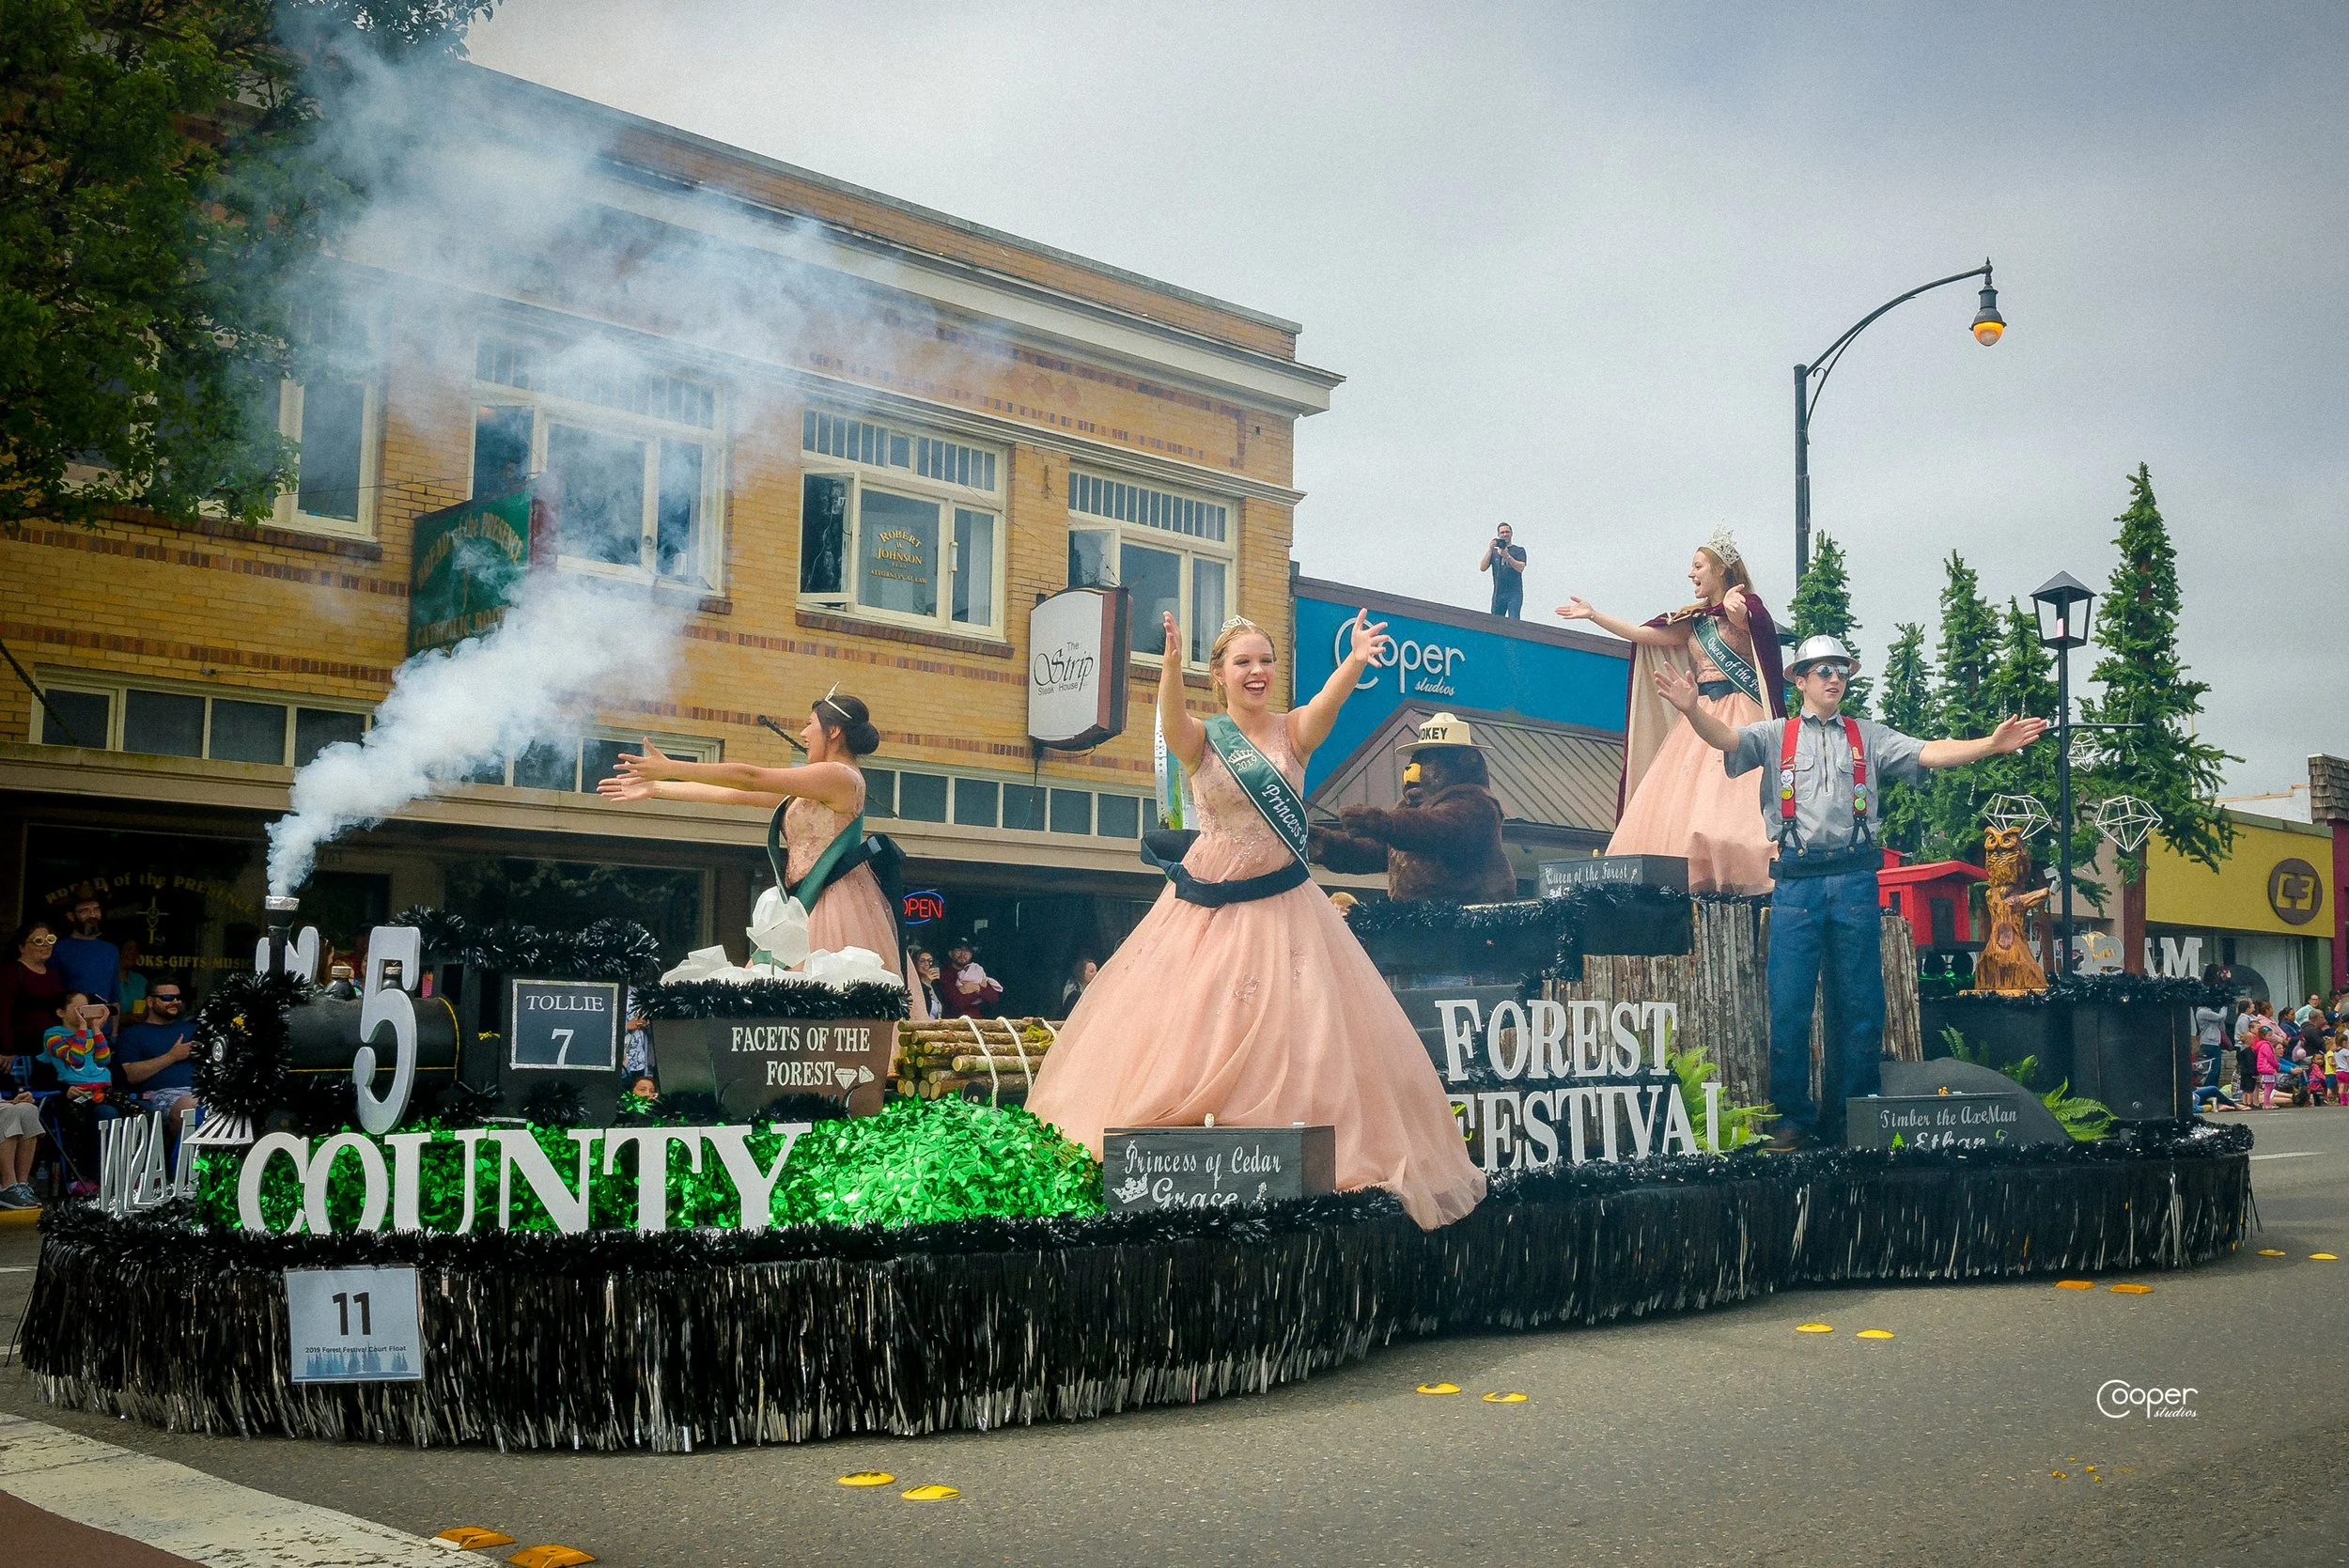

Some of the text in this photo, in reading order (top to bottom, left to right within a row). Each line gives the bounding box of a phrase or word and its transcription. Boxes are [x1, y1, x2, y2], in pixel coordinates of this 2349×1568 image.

[879, 529, 922, 549] ROBERT
[876, 547, 923, 565] JOHNSON
[1066, 642, 1080, 651] The
[1034, 648, 1094, 692] Strip
[1707, 637, 1727, 661] Queen
[1725, 660, 1741, 672] of
[1735, 668, 1750, 682] the
[1037, 687, 1054, 696] Steak
[1059, 682, 1079, 691] House
[1415, 676, 1455, 695] studios
[1236, 755, 1258, 772] 2019
[1262, 784, 1302, 837] Princess
[113, 872, 131, 887] of
[139, 872, 166, 888] the
[1545, 862, 1627, 885] Queen of the Forest
[526, 995, 604, 1012] TOLLIE
[551, 1028, 574, 1067] 7
[731, 1026, 870, 1052] FACETS OF THE
[1435, 999, 1678, 1081] FOREST
[766, 1061, 835, 1086] FOREST
[1880, 1105, 2017, 1128] Timber the AxeMan
[1915, 1130, 1986, 1150] Ethan
[1125, 1143, 1282, 1189] Princess of Cedar
[238, 1123, 812, 1235] COUNTY
[1152, 1177, 1238, 1209] Grace
[332, 1292, 372, 1336] 11
